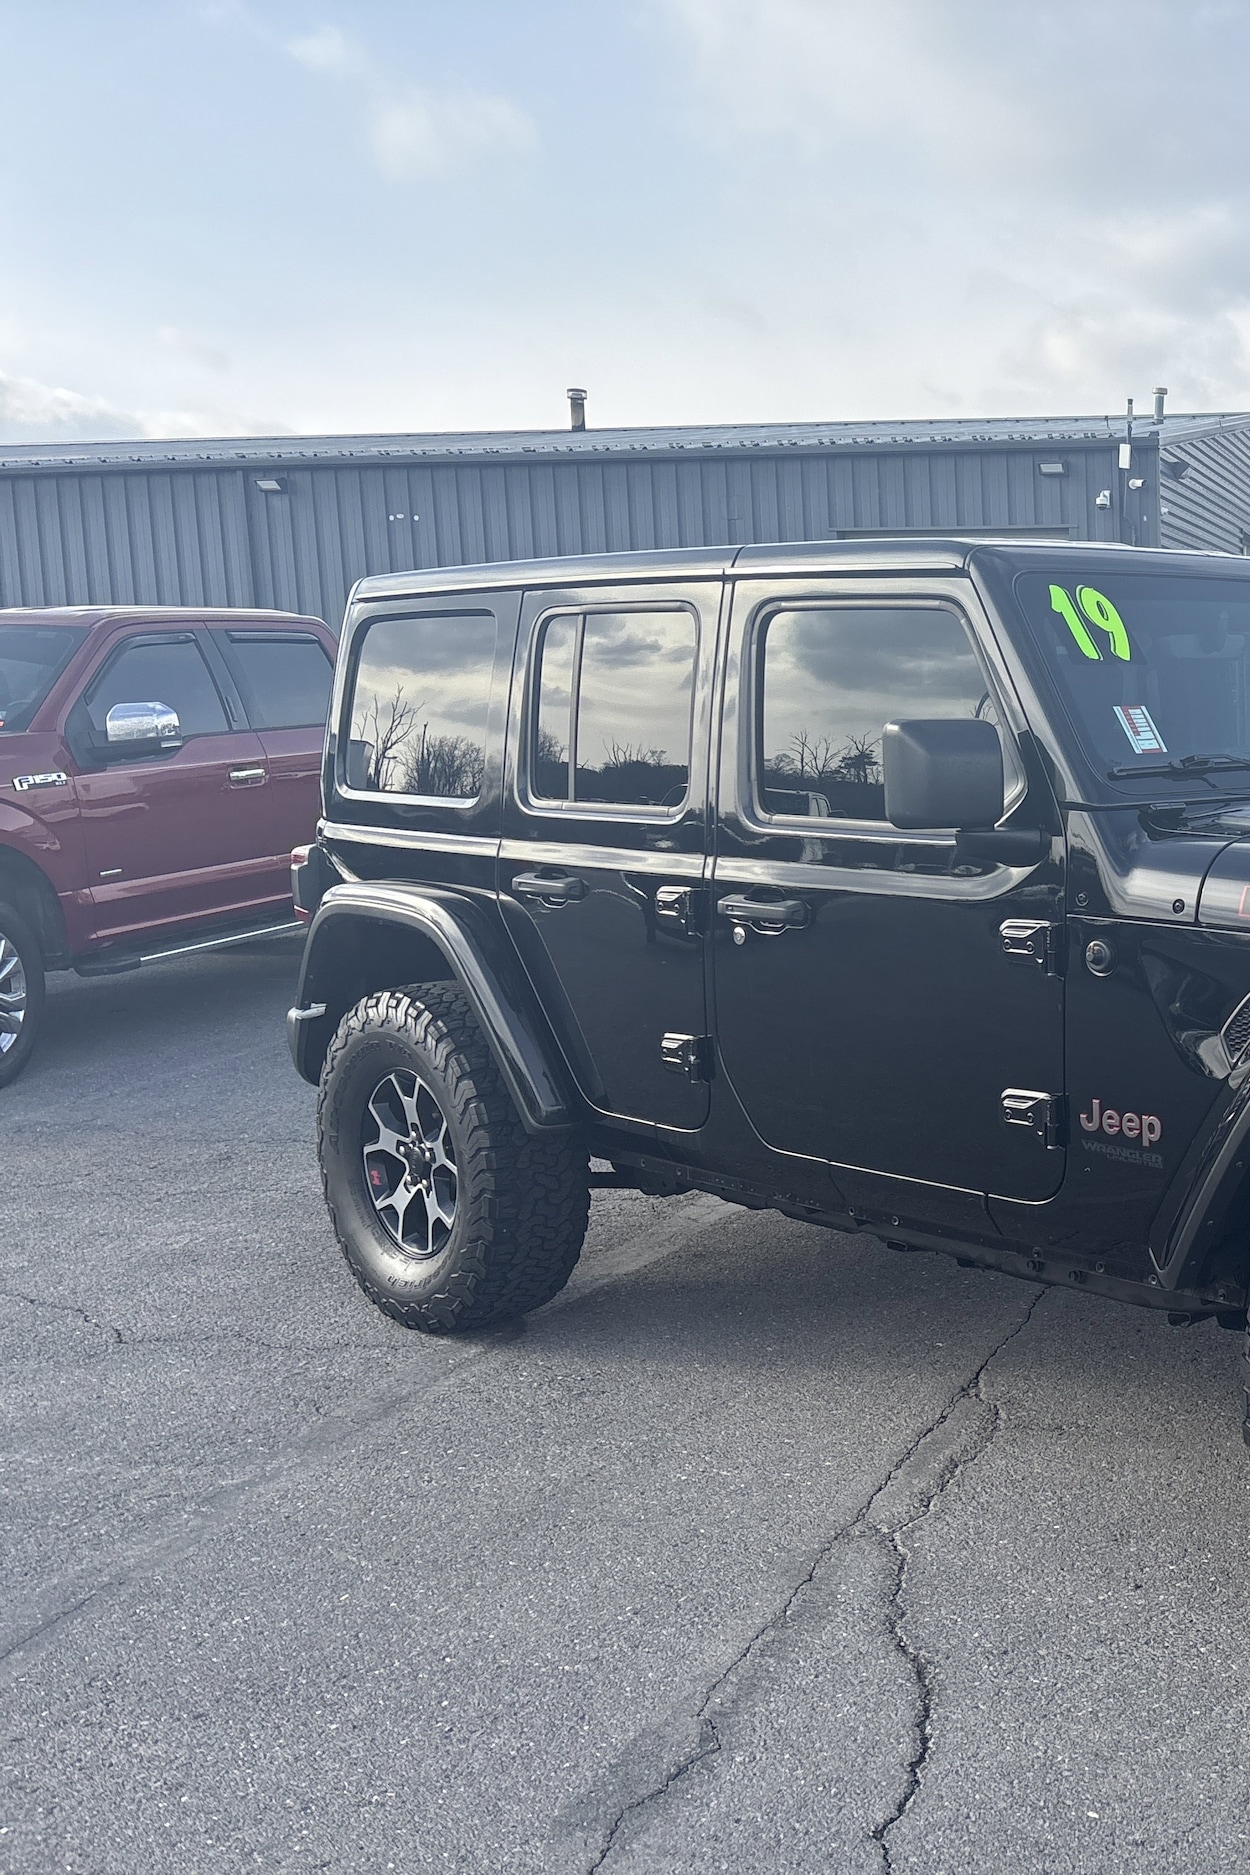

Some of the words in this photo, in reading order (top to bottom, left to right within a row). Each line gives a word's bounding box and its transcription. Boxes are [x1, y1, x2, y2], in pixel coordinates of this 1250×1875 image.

[1048, 583, 1132, 662] 19
[1079, 1098, 1163, 1148] Jeep
[1080, 1139, 1163, 1163] WRANGLER
[1106, 1153, 1164, 1169] UNLIMITED
